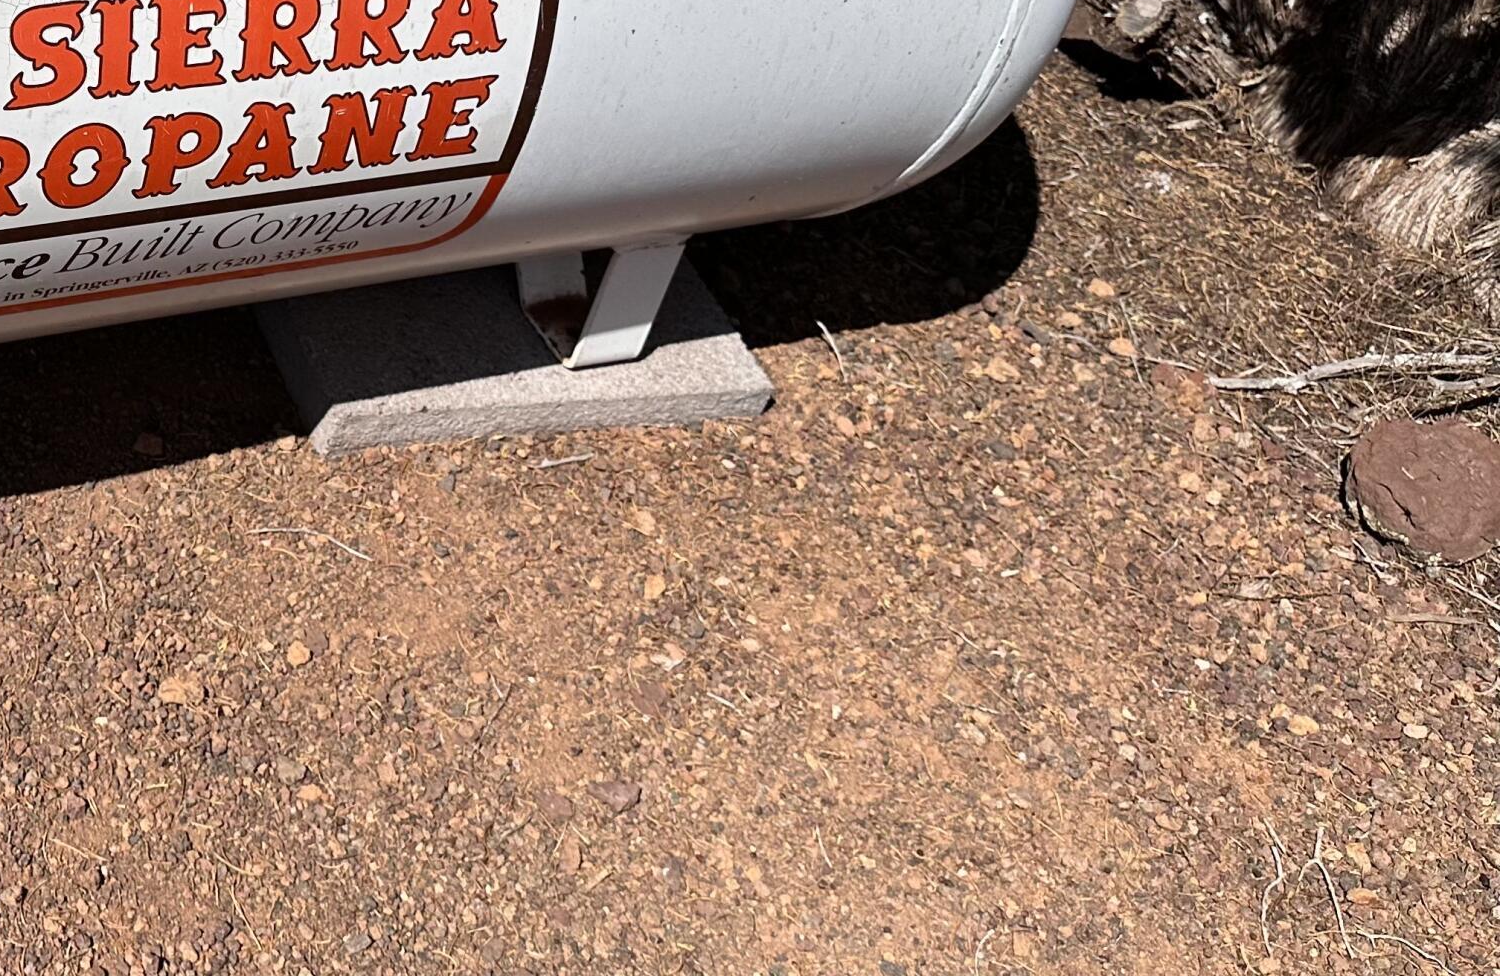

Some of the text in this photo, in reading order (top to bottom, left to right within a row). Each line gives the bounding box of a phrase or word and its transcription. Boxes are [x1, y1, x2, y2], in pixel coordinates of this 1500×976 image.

[53, 219, 205, 274] Built
[212, 190, 473, 250] Company
[3, 291, 25, 303] in
[30, 269, 172, 300] Springerville,
[176, 262, 208, 276] AZ
[212, 253, 267, 272] (520)
